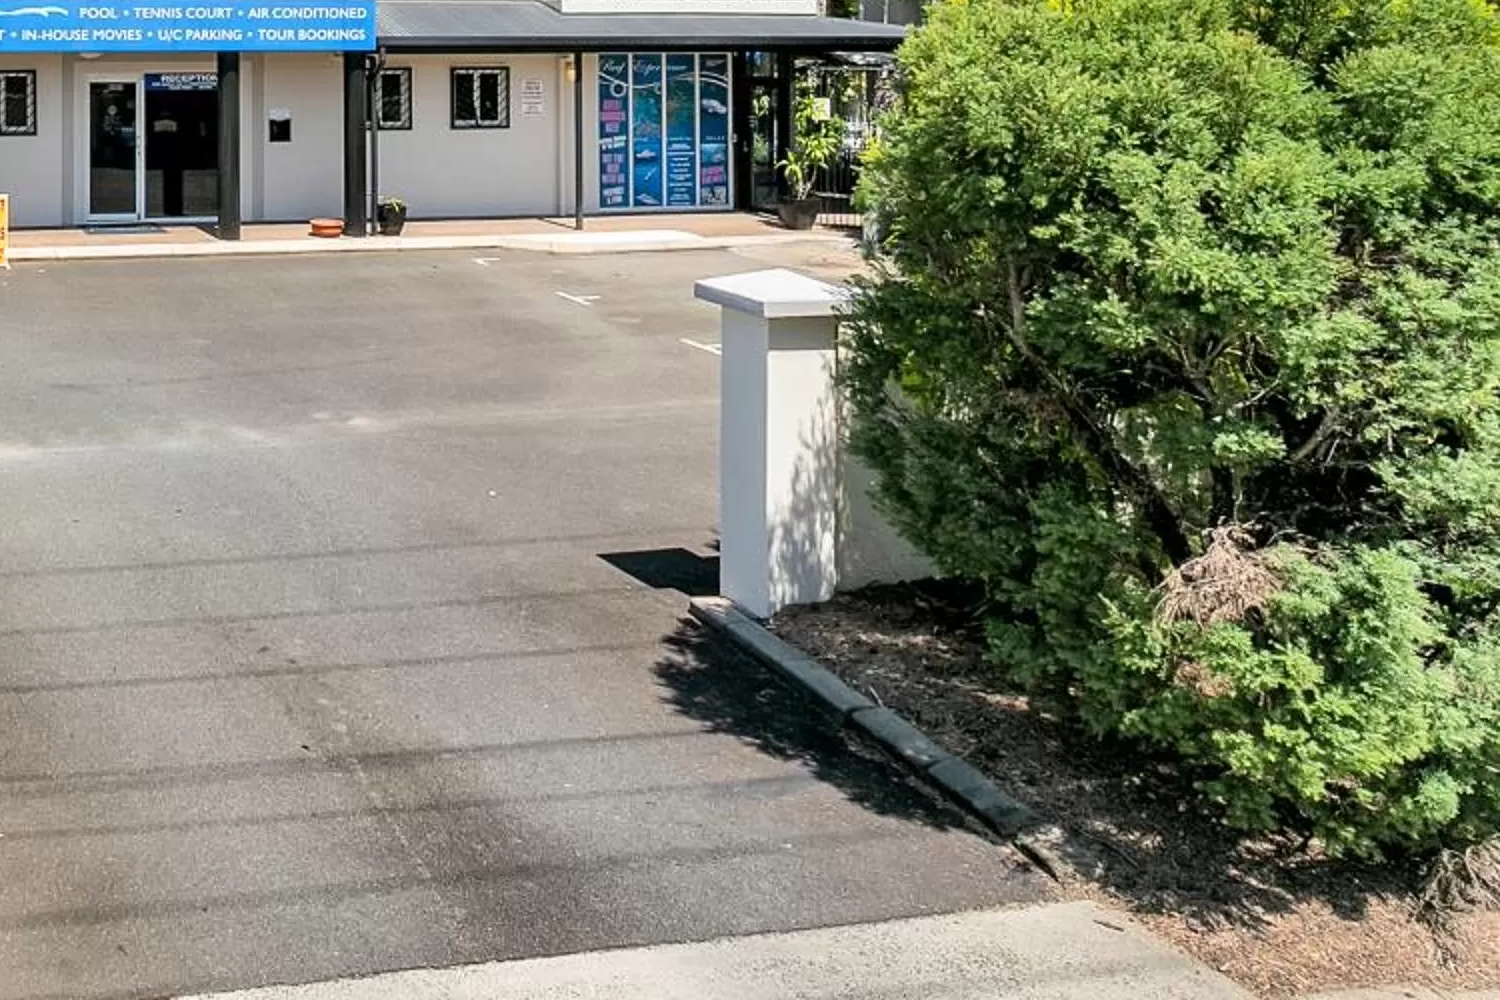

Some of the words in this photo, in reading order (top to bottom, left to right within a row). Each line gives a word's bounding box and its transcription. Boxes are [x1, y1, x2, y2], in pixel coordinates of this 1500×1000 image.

[79, 7, 118, 20] POOL
[133, 7, 183, 20] TENNIS
[185, 7, 233, 20] COURT
[248, 7, 271, 20] AIR
[271, 7, 367, 20] CONDITIONED
[21, 29, 89, 42] IN-HOUSE
[93, 29, 142, 42] MOVIES
[157, 29, 183, 42] U/C
[185, 29, 243, 42] PARKING
[257, 29, 296, 42] TOUR
[298, 29, 366, 42] BOOKINGS
